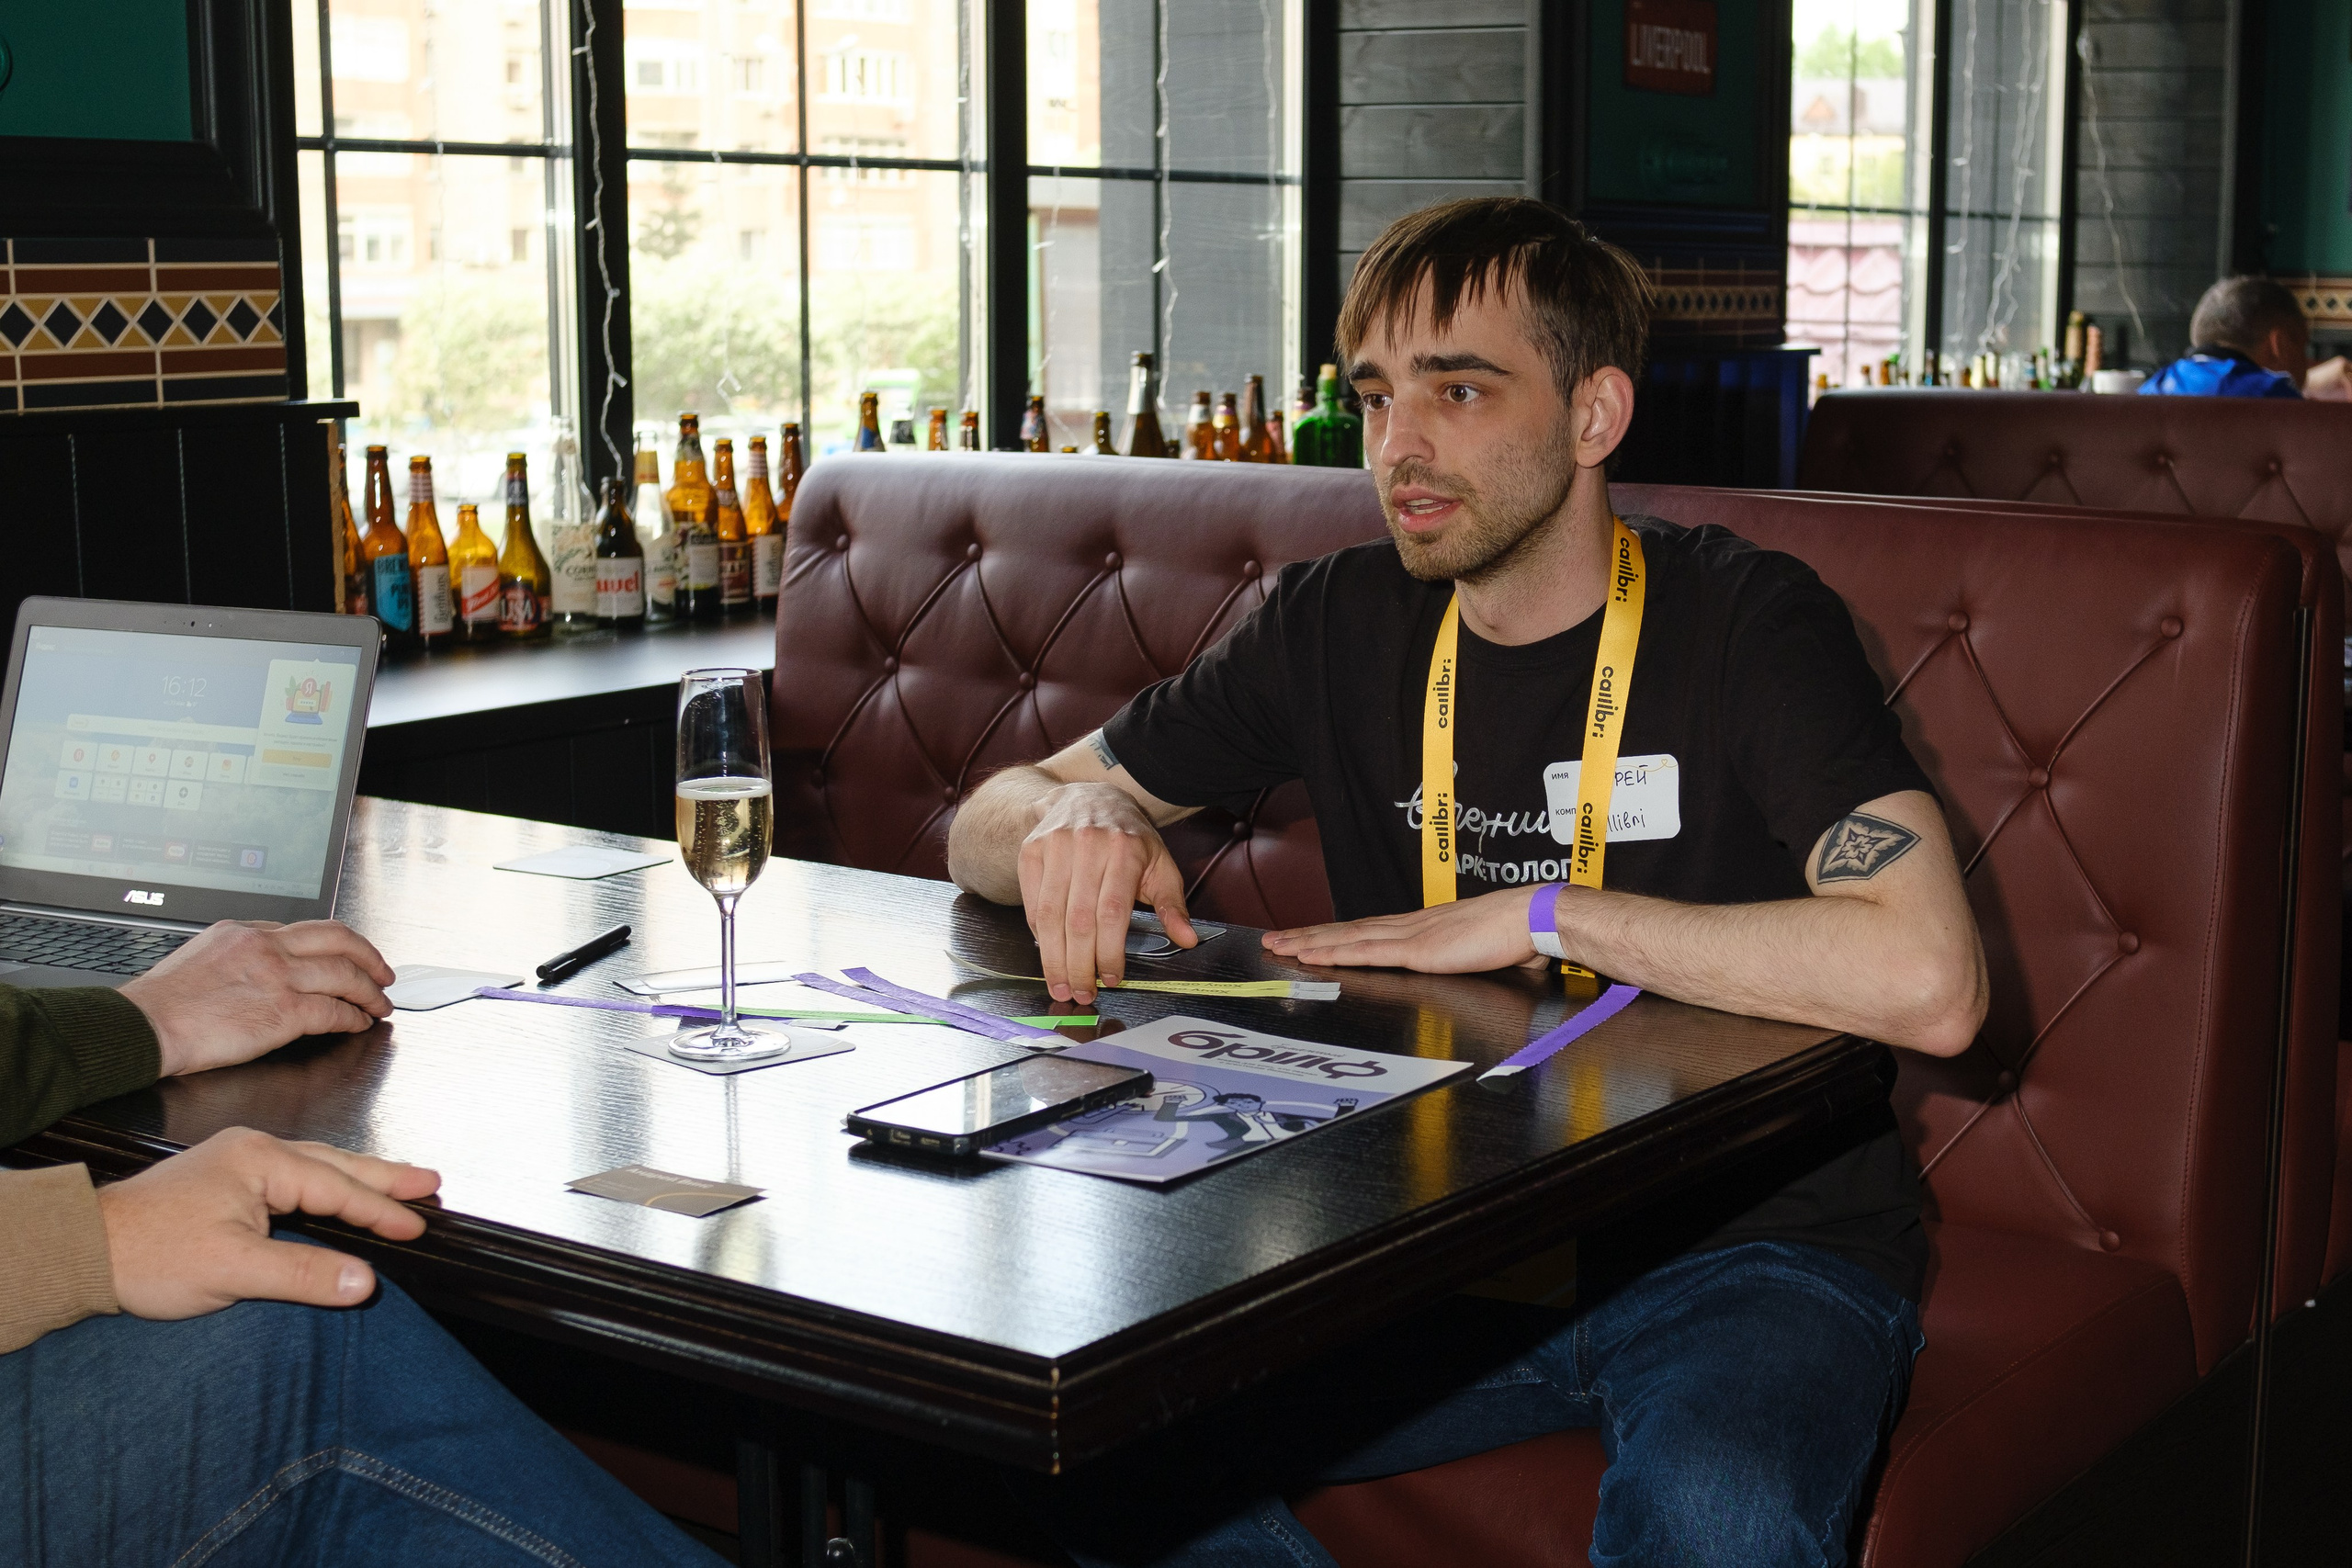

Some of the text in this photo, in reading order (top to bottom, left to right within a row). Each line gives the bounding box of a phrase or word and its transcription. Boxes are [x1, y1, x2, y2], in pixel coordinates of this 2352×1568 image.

[162, 675, 208, 698] 16:12
[1551, 772, 1569, 781] ИМЯ
[1614, 764, 1648, 787] РЕЙ
[1555, 807, 1577, 817] КОМП
[123, 889, 165, 906] ASUS
